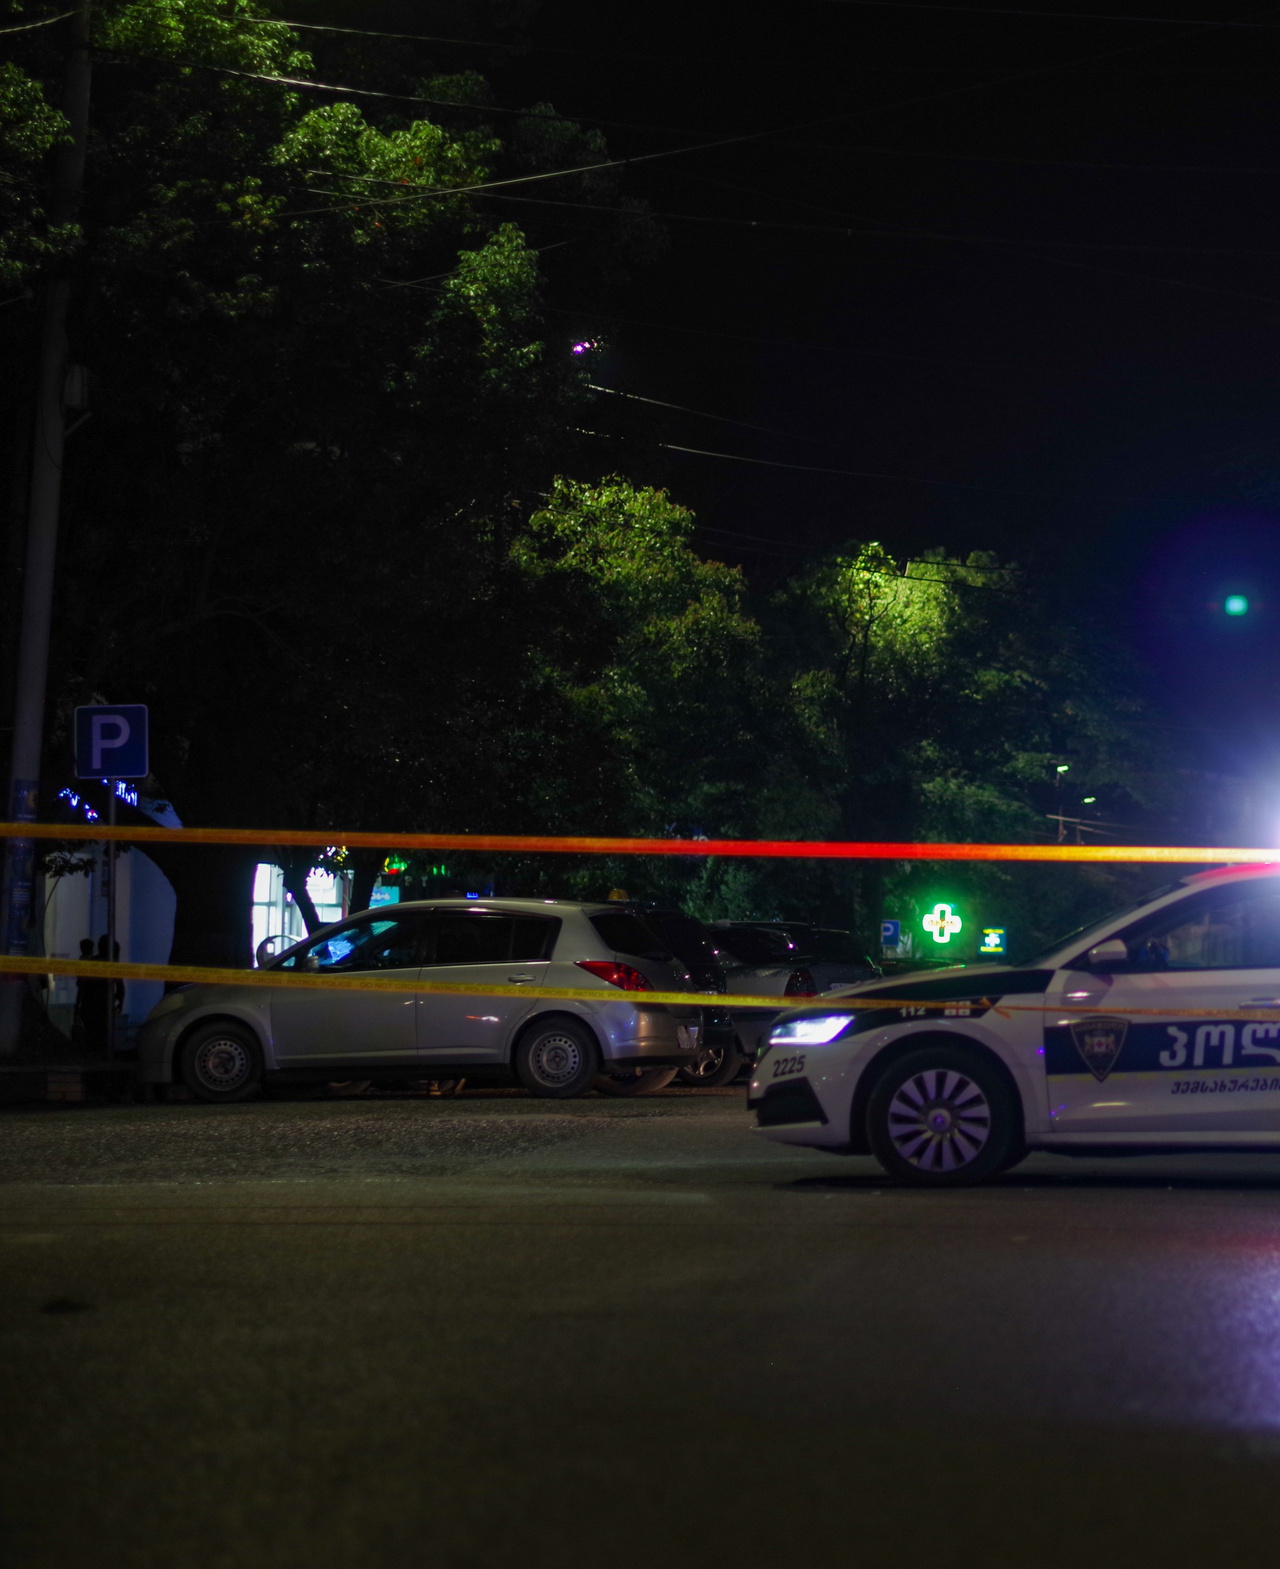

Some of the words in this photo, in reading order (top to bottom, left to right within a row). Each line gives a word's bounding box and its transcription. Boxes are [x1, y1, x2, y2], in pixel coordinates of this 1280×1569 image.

[92, 714, 130, 769] P
[503, 988, 515, 996] DO
[519, 989, 535, 997] NOT
[899, 1007, 926, 1018] 112
[773, 1054, 807, 1078] 2225
